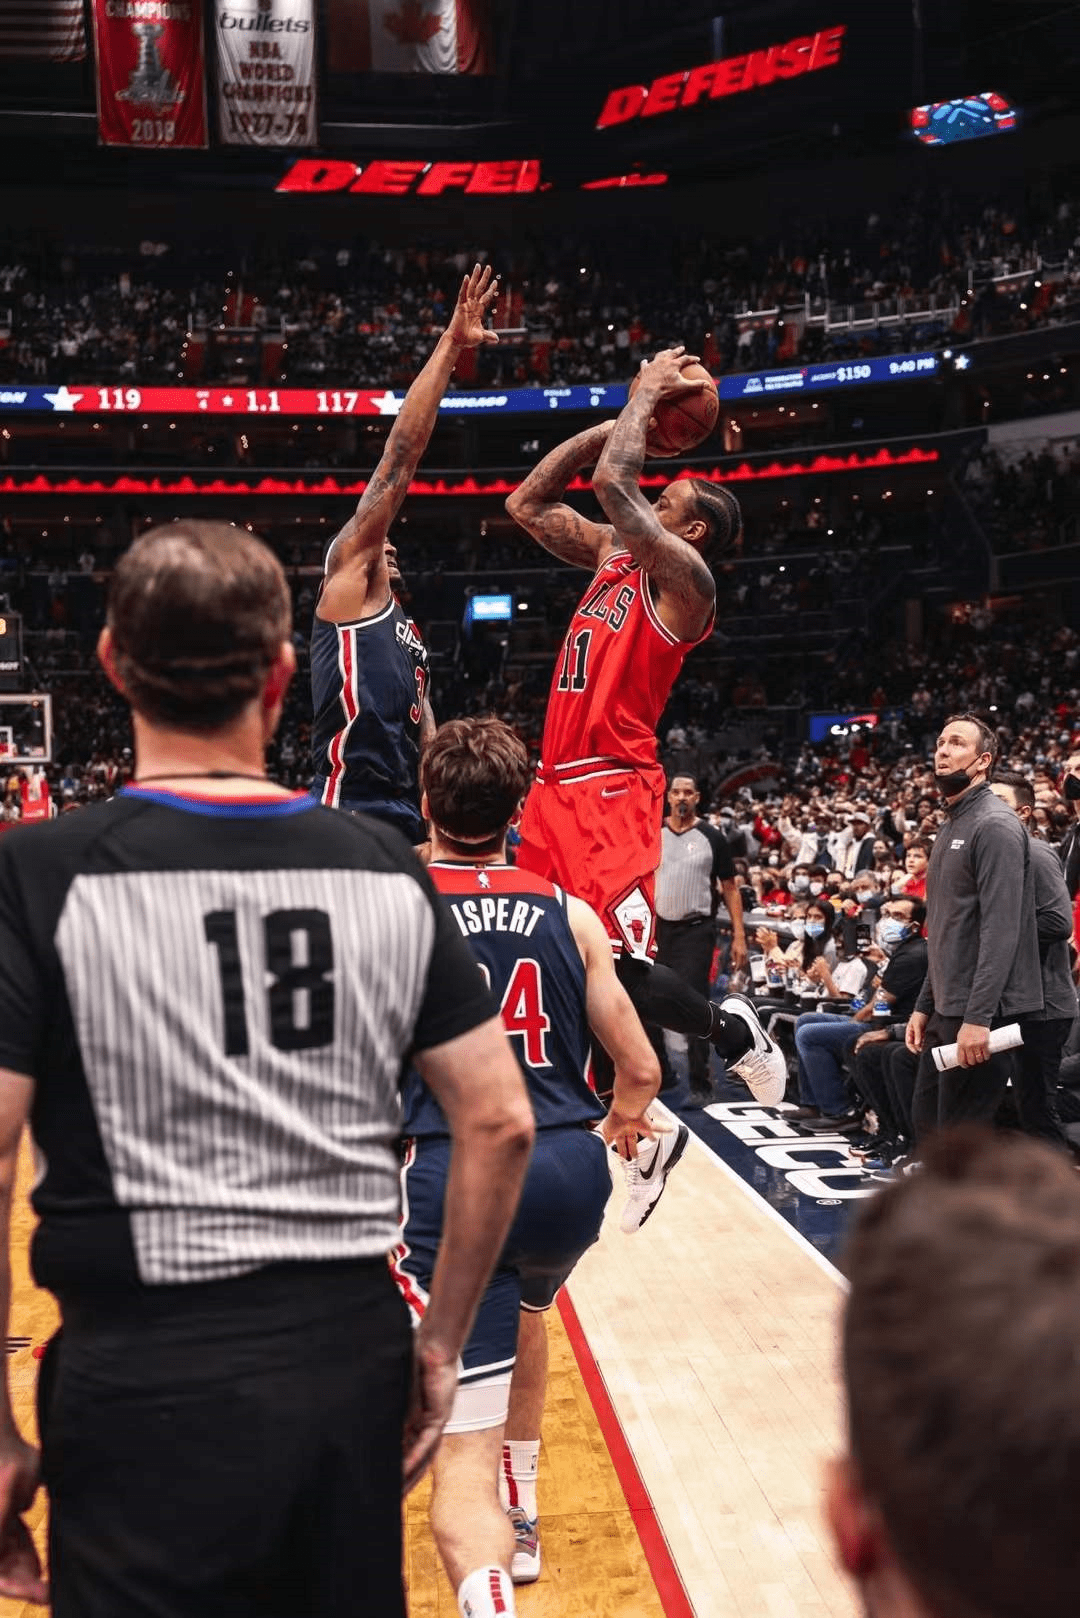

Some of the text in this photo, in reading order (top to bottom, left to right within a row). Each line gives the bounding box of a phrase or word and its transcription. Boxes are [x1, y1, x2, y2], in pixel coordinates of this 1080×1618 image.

[220, 12, 309, 33] bullets
[249, 41, 281, 60] NBA
[238, 61, 294, 82] WORLD
[596, 24, 847, 129] DEFENSE
[131, 119, 176, 142] 2018
[836, 364, 872, 383] $150
[97, 388, 142, 410] 119
[246, 391, 281, 412] 1.1
[316, 391, 359, 412] 117
[557, 628, 593, 692] 11
[450, 897, 546, 938] ISPERT
[203, 908, 335, 1057] 18
[476, 957, 554, 1069] 4
